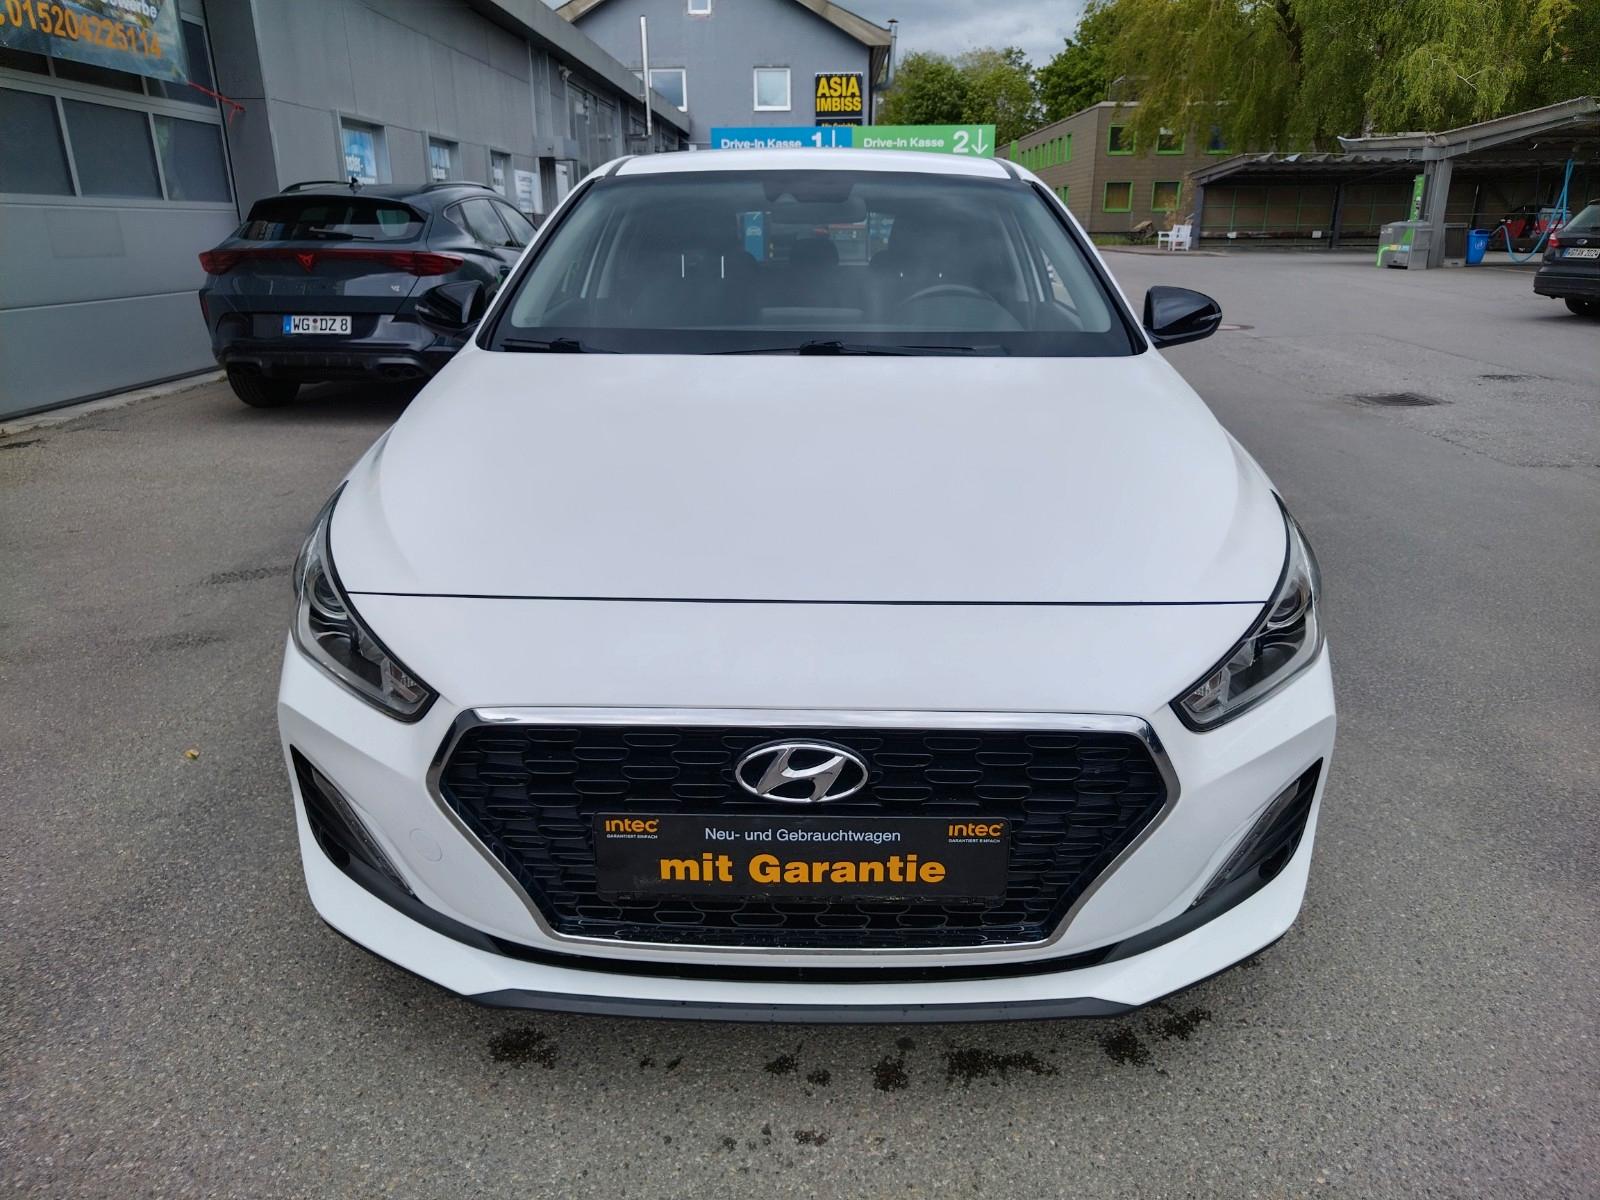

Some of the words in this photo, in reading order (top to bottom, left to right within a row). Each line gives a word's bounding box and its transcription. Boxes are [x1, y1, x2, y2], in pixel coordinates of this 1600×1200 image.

[816, 76, 861, 97] ASIA
[816, 97, 862, 112] IMBISS
[720, 138, 765, 149] Drive-In
[767, 139, 802, 148] Kasse
[811, 132, 823, 148] 1
[863, 137, 908, 148] Drive-In
[909, 137, 945, 148] Kasse
[952, 130, 970, 153] 2
[293, 317, 310, 331] WG
[319, 318, 337, 331] DZ
[340, 318, 348, 331] 8
[605, 818, 657, 832] intec
[948, 823, 1001, 837] intec
[705, 828, 741, 841] Neu-
[744, 829, 772, 842] und
[776, 829, 901, 844] Gebrauchtwagen
[660, 852, 733, 882] mit
[748, 854, 946, 884] Garantie
